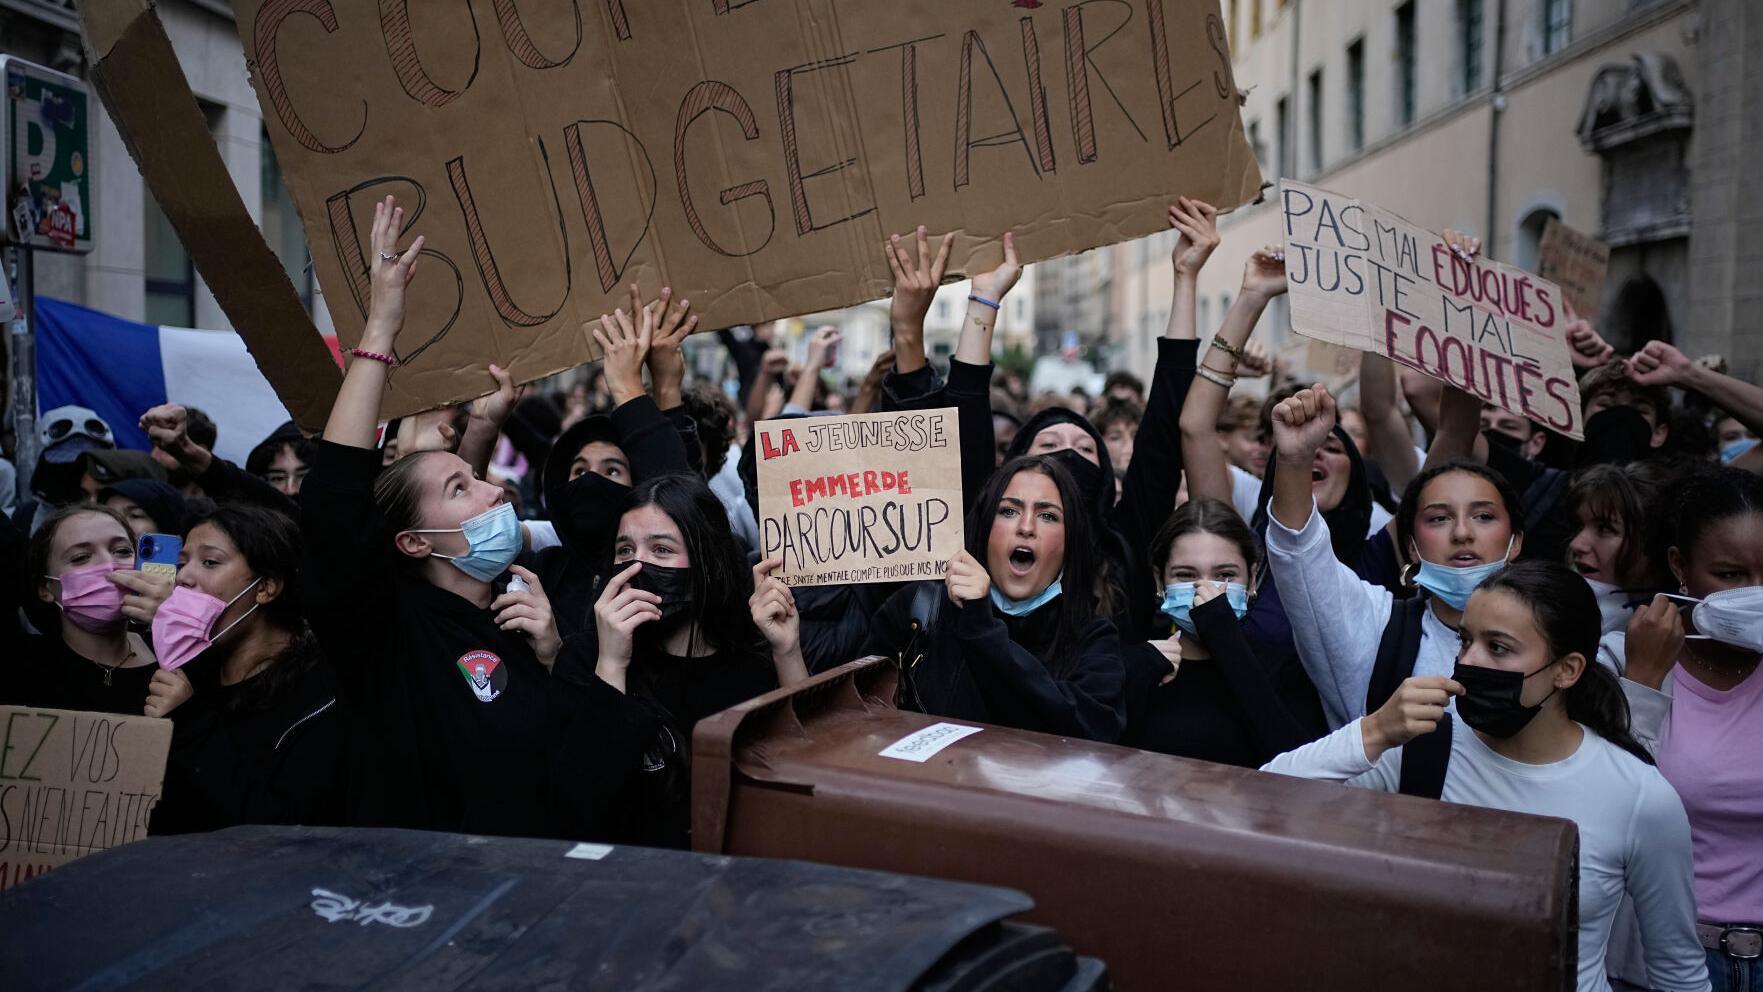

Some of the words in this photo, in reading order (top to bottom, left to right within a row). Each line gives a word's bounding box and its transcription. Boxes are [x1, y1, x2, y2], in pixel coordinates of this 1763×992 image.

[1281, 188, 1370, 252] PAS
[1374, 218, 1431, 282] MAL
[1289, 242, 1421, 321] JUSTE
[1442, 294, 1540, 364] MAL
[760, 428, 801, 460] LA
[805, 414, 948, 453] JEUNESSE
[788, 470, 913, 508] EMMERDE
[764, 497, 950, 577] PARCOURSUP
[816, 570, 849, 584] MENTALE
[850, 566, 882, 582] COMPTE
[916, 561, 932, 576] NOS
[69, 716, 127, 784] VOS
